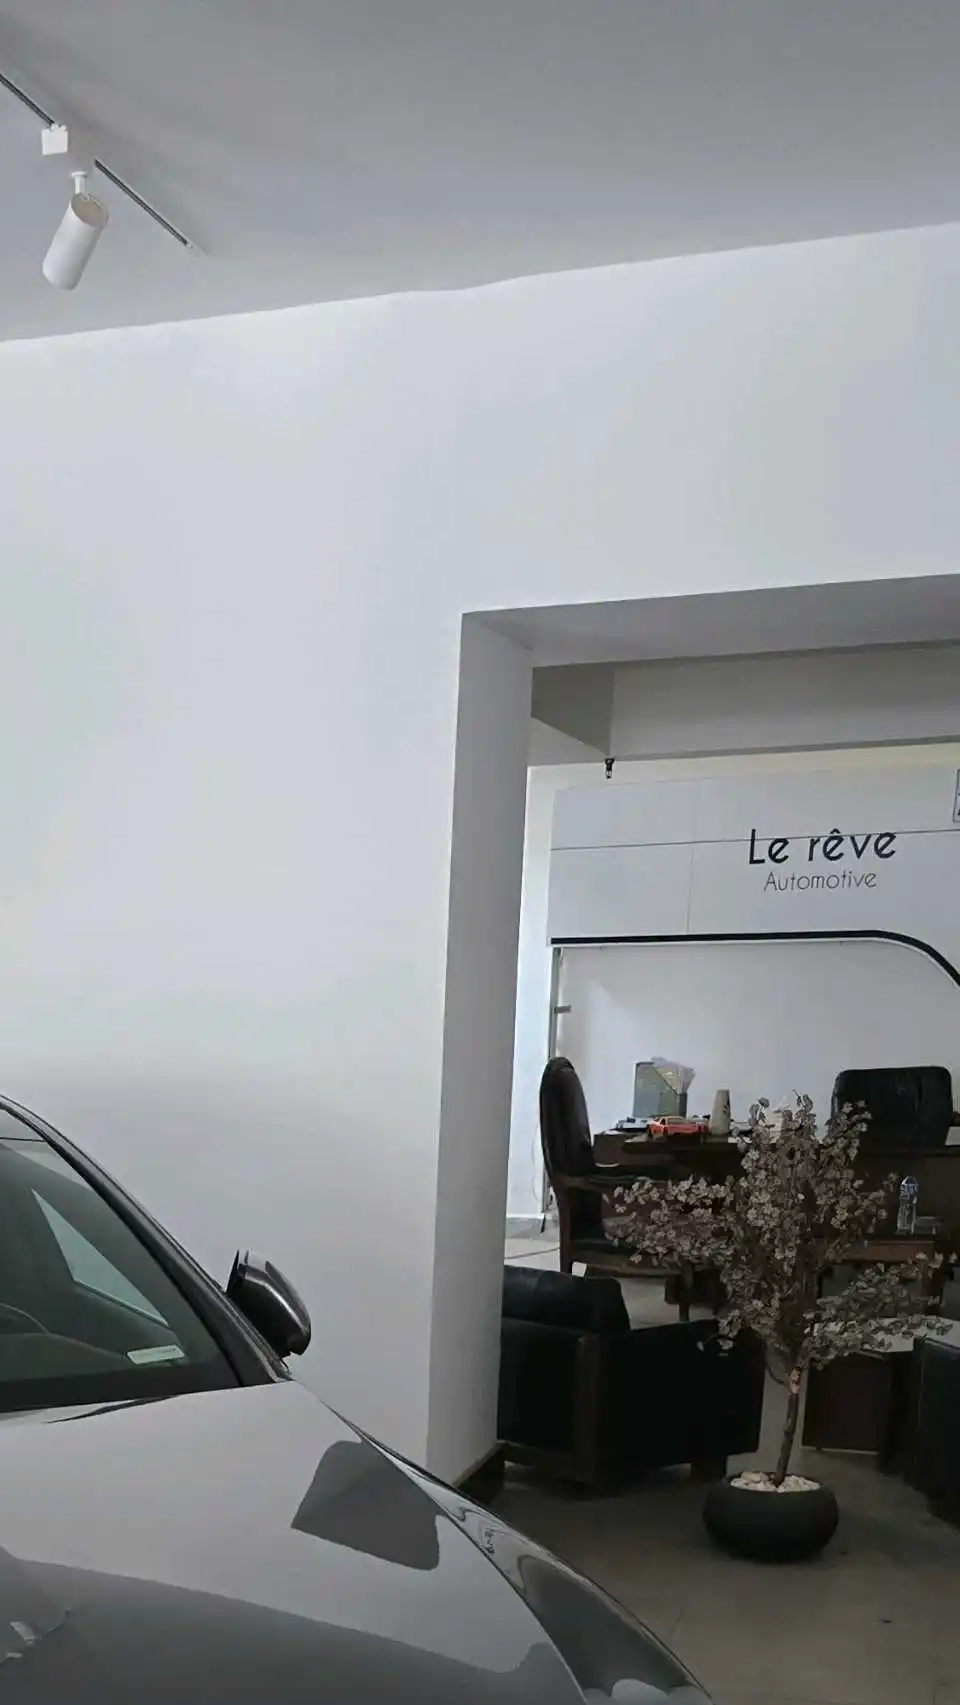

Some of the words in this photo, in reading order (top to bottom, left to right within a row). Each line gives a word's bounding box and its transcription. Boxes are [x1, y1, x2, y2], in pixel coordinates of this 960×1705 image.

[748, 828, 790, 865] Le
[807, 828, 897, 862] rêve
[763, 870, 877, 893] Automotive
